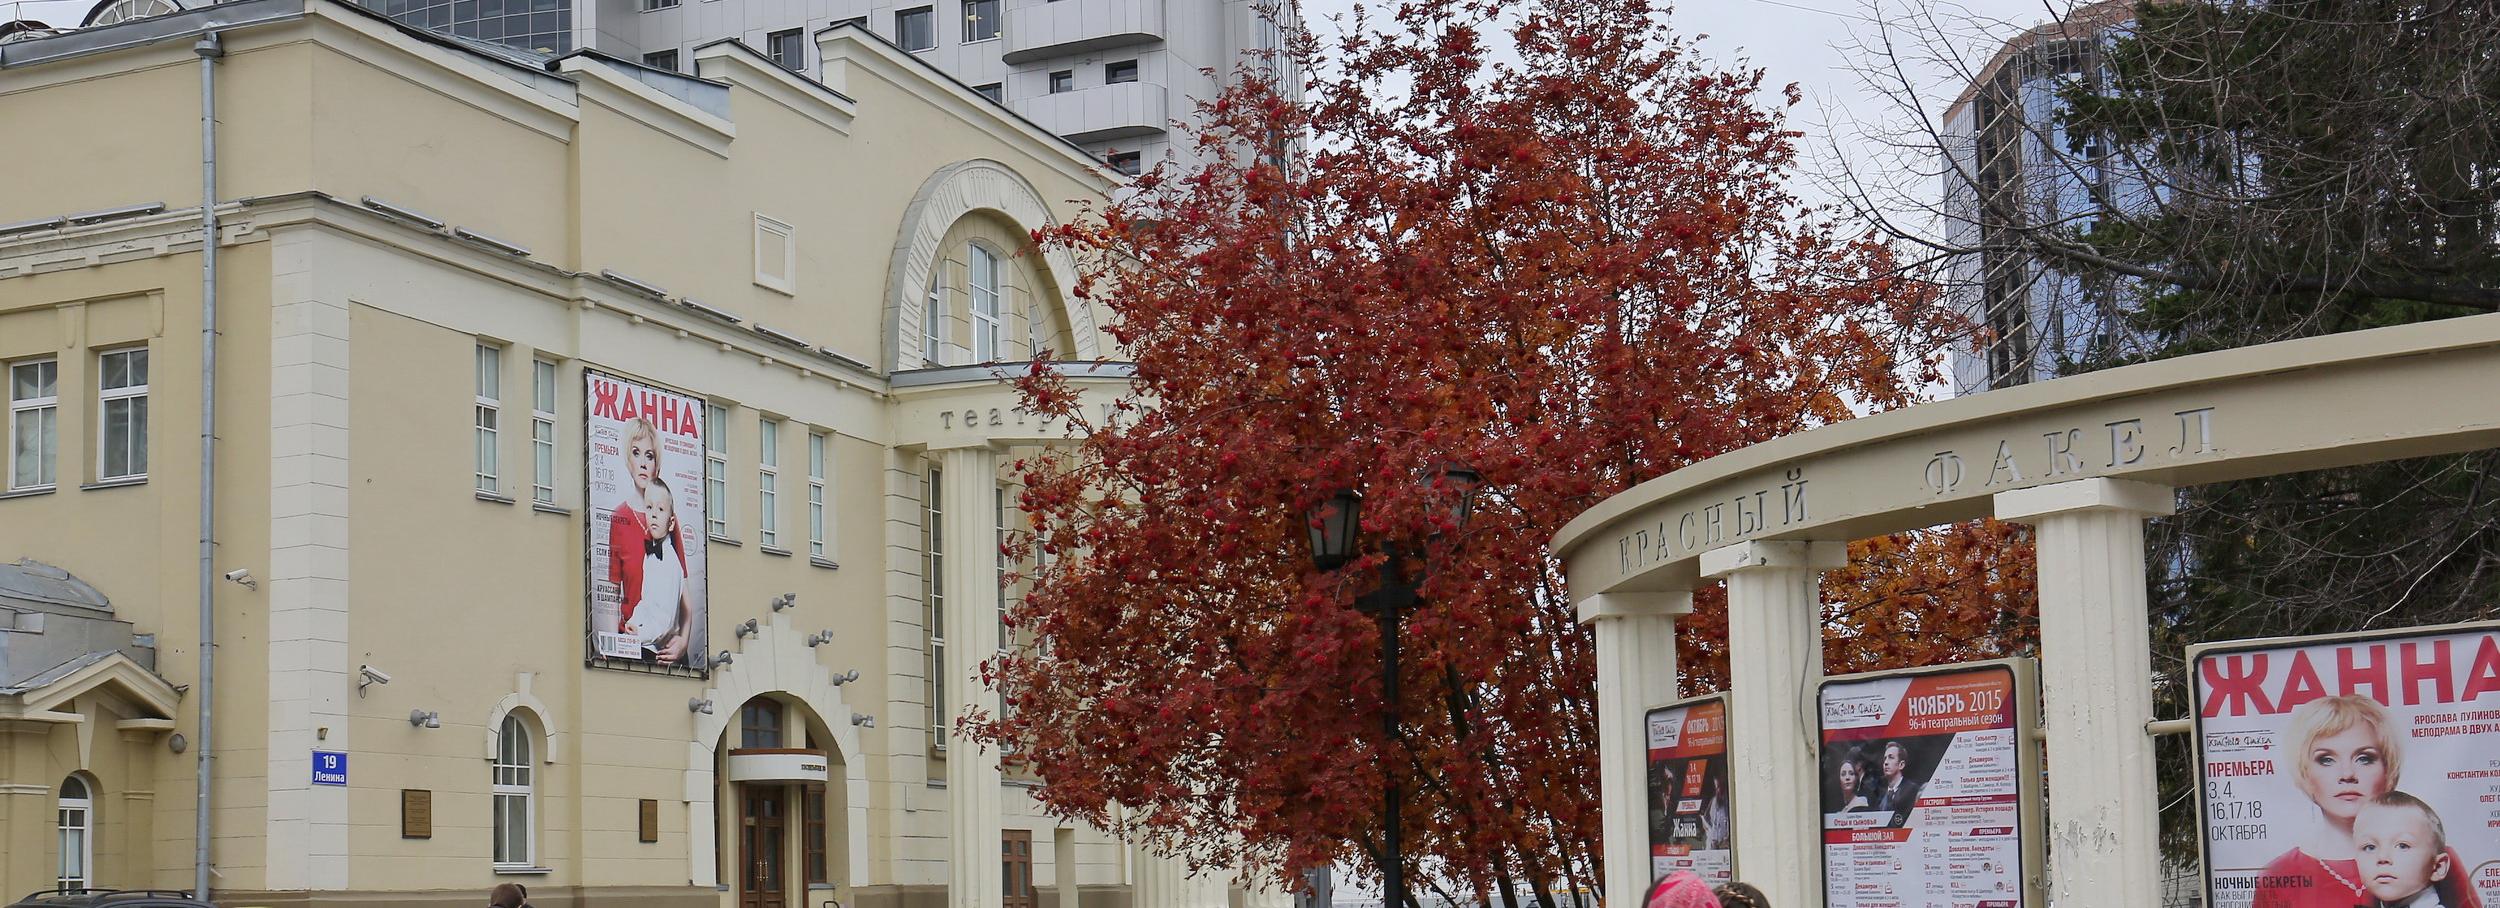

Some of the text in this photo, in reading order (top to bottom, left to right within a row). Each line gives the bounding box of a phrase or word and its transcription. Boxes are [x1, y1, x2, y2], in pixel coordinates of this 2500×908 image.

[593, 379, 698, 439] ЖАННА
[1618, 407, 2224, 577] КРАСНЫЙ ФАКЕЛ
[2202, 636, 2500, 718] ЖАННА
[1908, 689, 2002, 716] НОЯБРЬ 2015
[1909, 713, 2003, 730] 96-й театральный сезон
[2414, 713, 2458, 725] ЯРОСЛАВА
[2411, 727, 2461, 738] МЕЛОДРАМА
[2462, 726, 2468, 734] В
[2469, 723, 2492, 735] ДВУХ
[323, 755, 337, 768] 19
[2207, 760, 2275, 778] ПРЕМЬЕРА
[314, 771, 345, 782] Ленина
[2447, 770, 2489, 780] КОНСТАНТИН
[2480, 794, 2495, 803] ОЛЕГ
[1673, 818, 1697, 837] Жанна
[2211, 823, 2267, 842] ОКТЯБРЯ
[1852, 831, 1894, 841] БОЛЬШОЙ ЗАЛ
[2215, 875, 2313, 889] НОЧНЫЕ СЕКРЕТЫ
[2215, 890, 2231, 901] КАК
